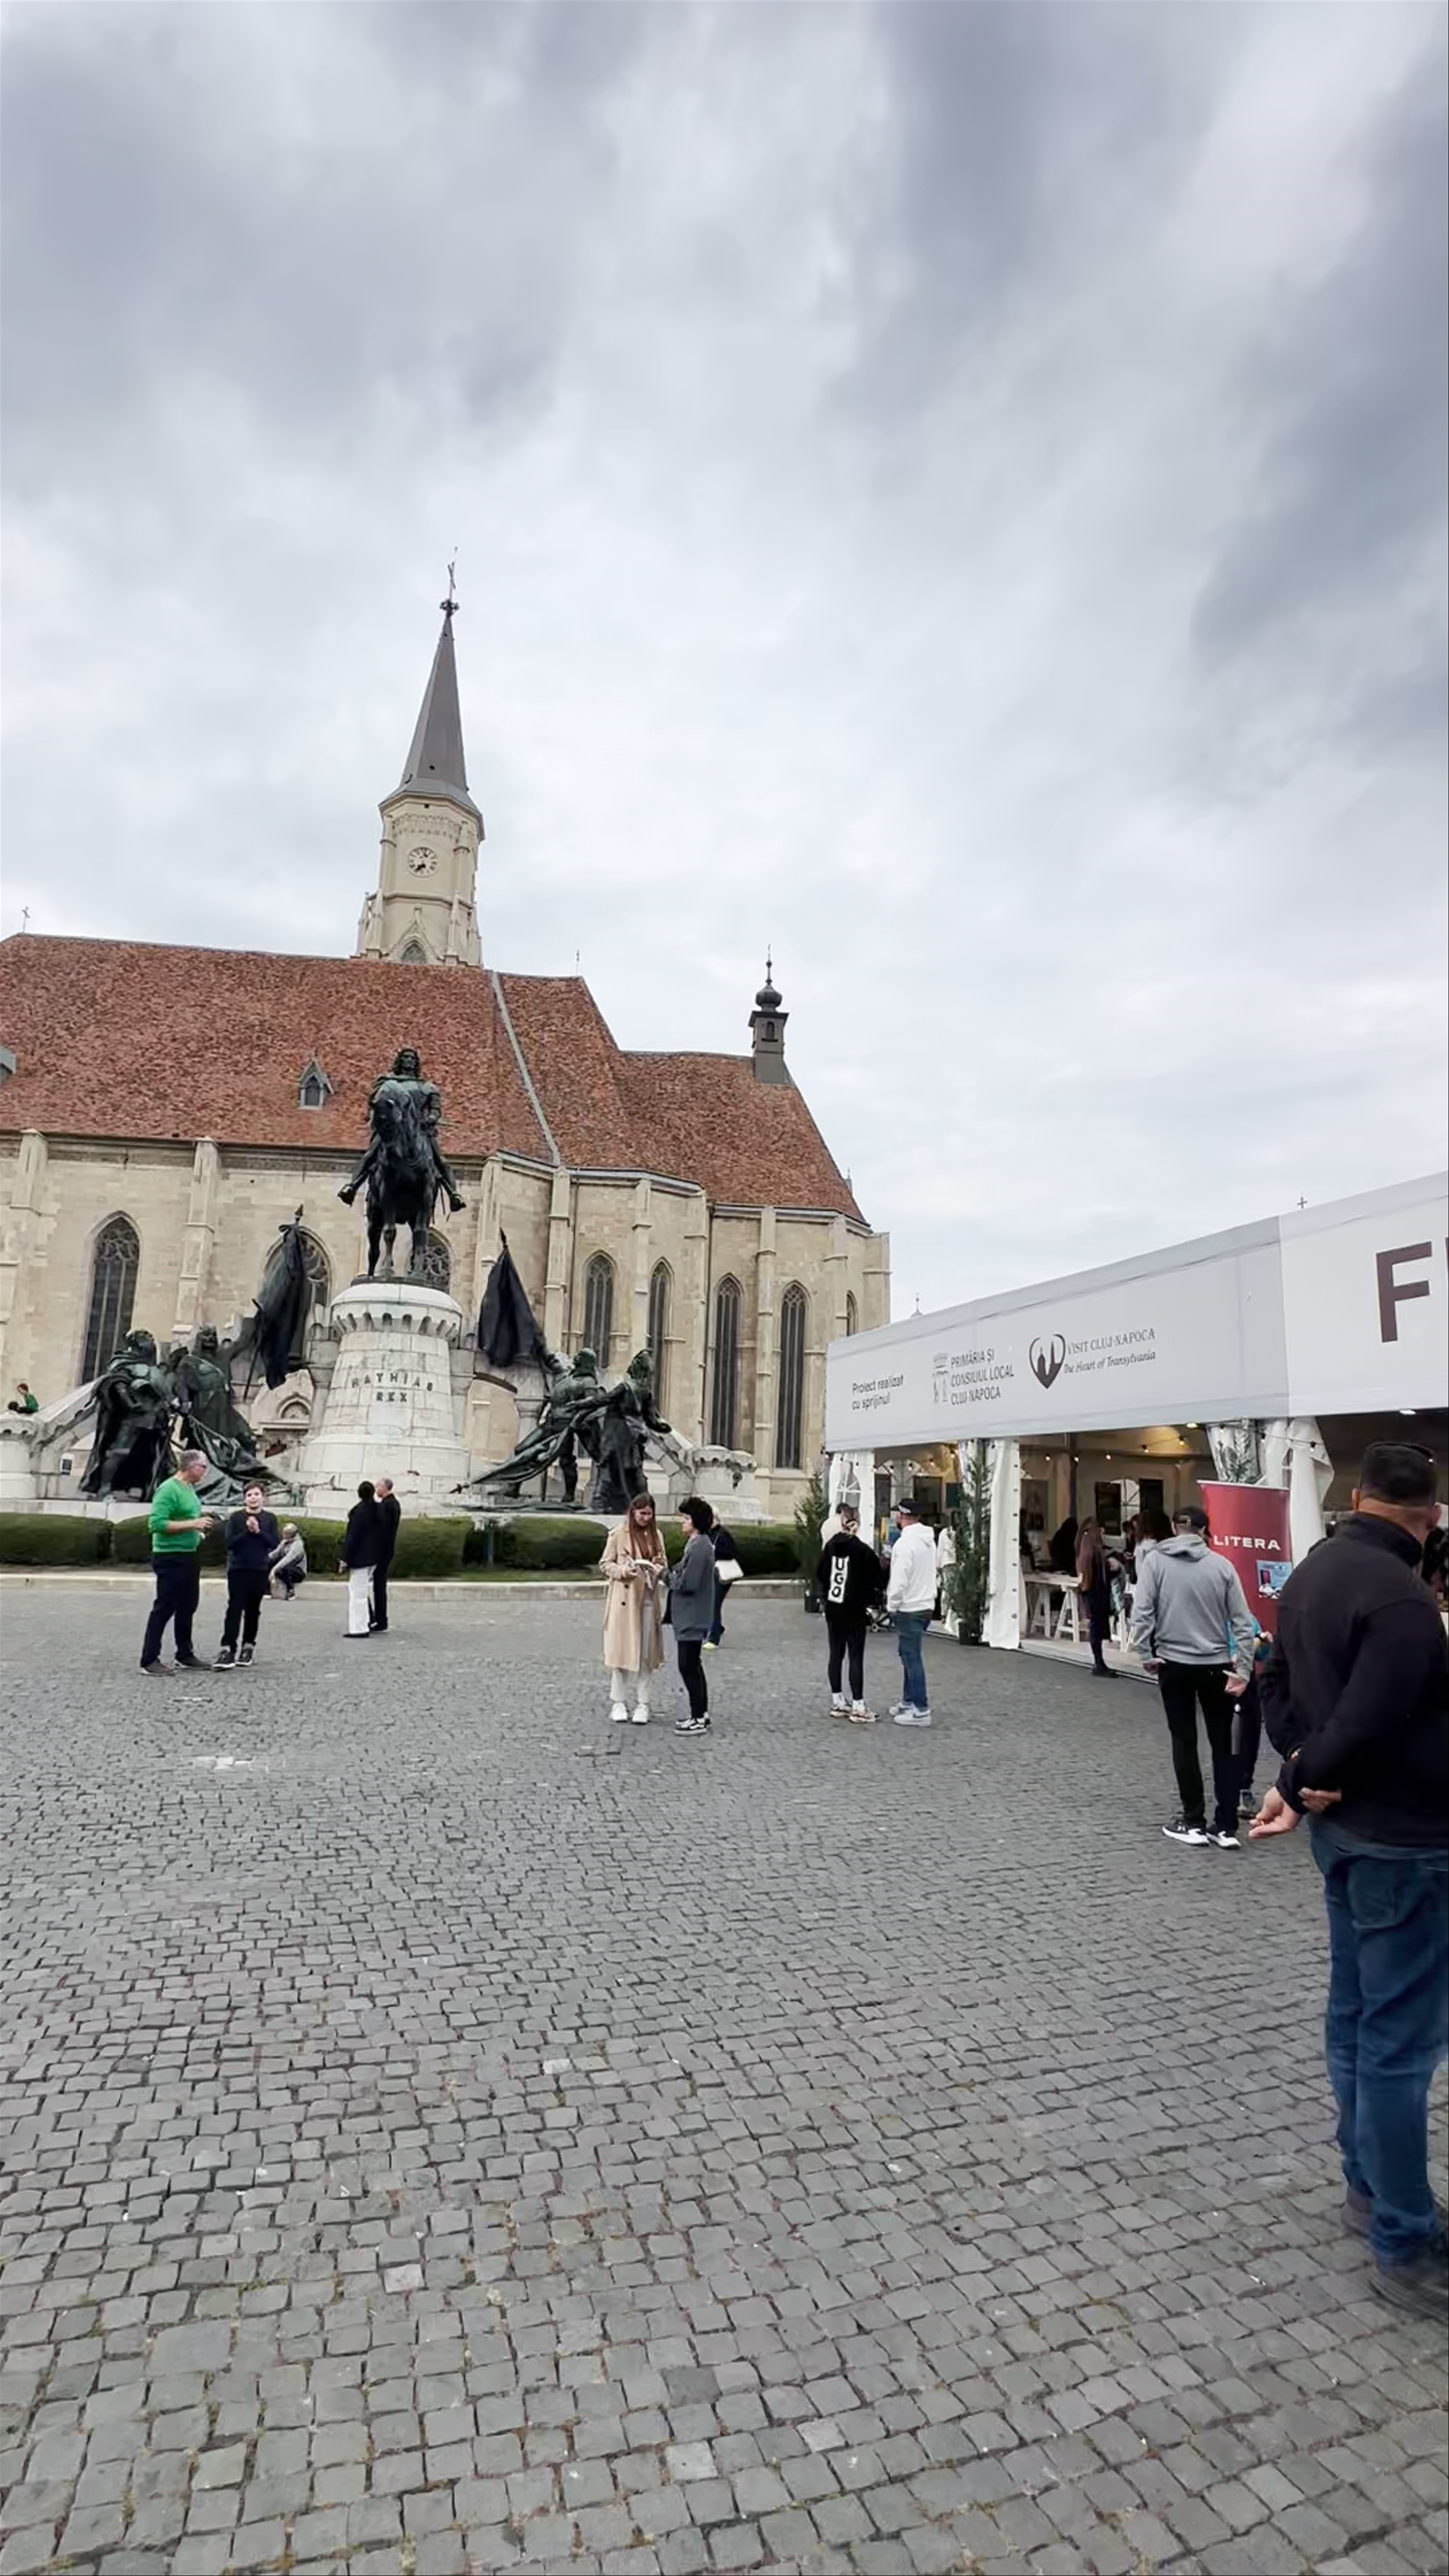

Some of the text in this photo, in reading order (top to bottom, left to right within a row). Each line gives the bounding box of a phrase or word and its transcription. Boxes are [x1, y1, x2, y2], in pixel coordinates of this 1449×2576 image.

[1376, 1237, 1448, 1343] F
[1068, 1328, 1155, 1354] VISIT CLUJ-NAPOCA
[1064, 1349, 1155, 1373] The Heart of Transylvania
[989, 1364, 1014, 1380] LOCAL
[352, 1373, 433, 1391] MATHIAS
[878, 1375, 903, 1389] realizat
[377, 1392, 407, 1402] REX
[852, 1392, 891, 1410] cu sprijinul
[1213, 1535, 1281, 1550] LITERA
